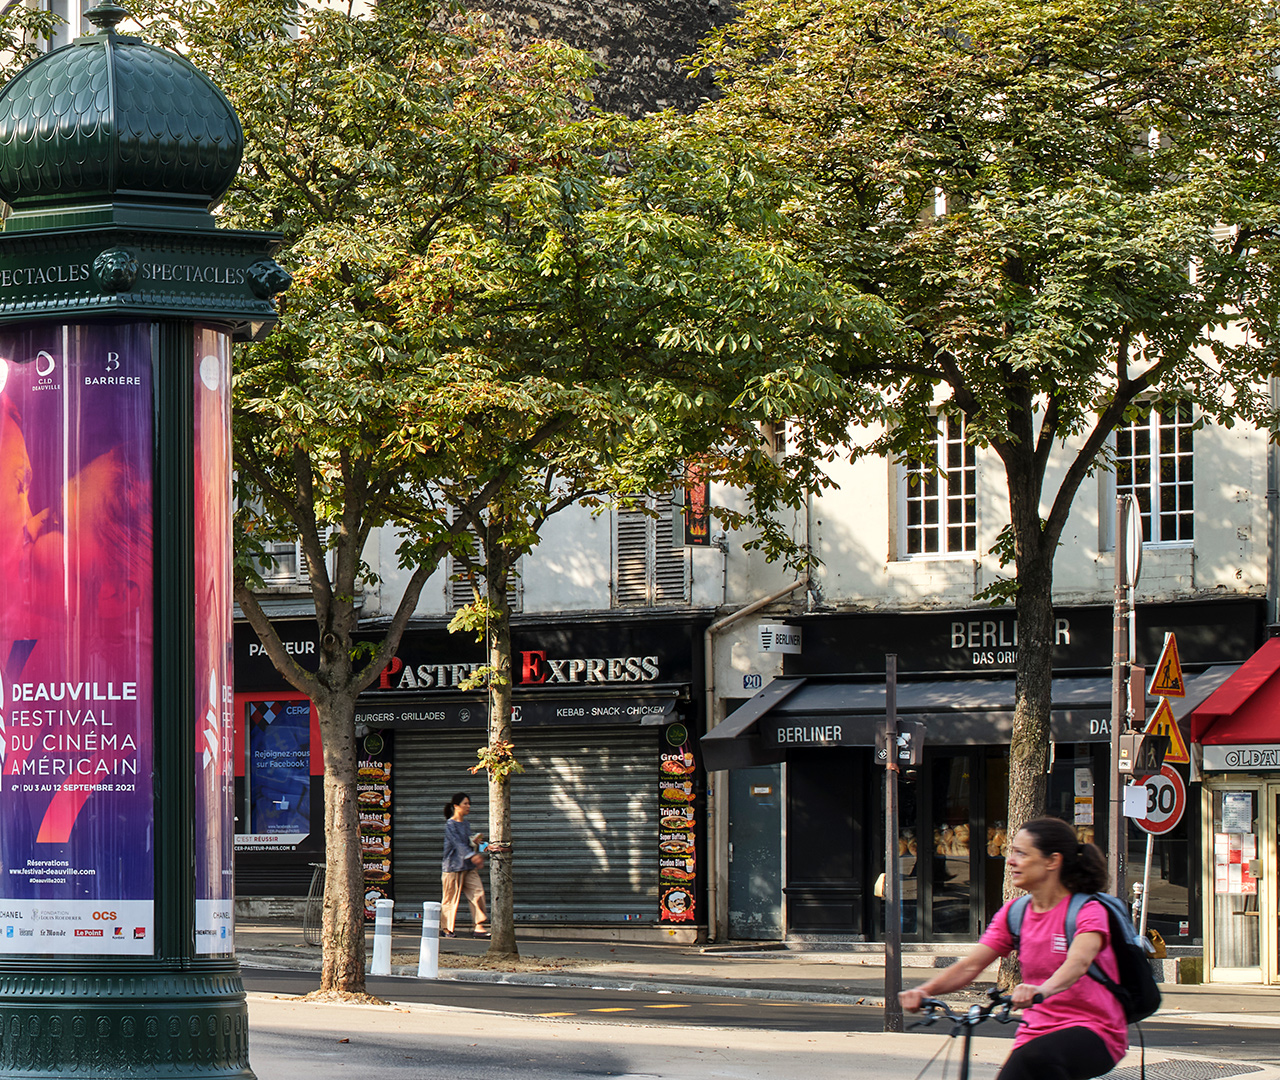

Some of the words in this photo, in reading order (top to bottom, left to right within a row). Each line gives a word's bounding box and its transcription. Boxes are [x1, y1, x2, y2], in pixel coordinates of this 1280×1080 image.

[142, 262, 246, 285] SPECTACLES
[85, 375, 140, 385] BARRIÈRE
[775, 634, 801, 646] BERLINER
[951, 619, 1071, 649] BERLIR
[249, 641, 315, 656] PAEUR
[972, 652, 995, 665] DAS
[997, 651, 1018, 664] ORI
[519, 650, 660, 684] EXPRESS
[744, 675, 762, 689] 20
[12, 682, 137, 702] DEAUVILLE
[286, 706, 303, 715] CER
[354, 712, 395, 722] BURGERS
[401, 711, 446, 721] GRILLADES
[556, 707, 585, 717] KEBAB
[591, 706, 621, 716] SNACK
[626, 706, 665, 715] CHICKEN
[12, 709, 114, 727] FESTIVAL
[778, 726, 843, 743] BERLINER
[12, 734, 34, 751] DU
[42, 731, 137, 751] CINÉMA
[255, 750, 311, 760] Rejoignez-nous
[12, 756, 137, 776] AMÉRICAIN
[270, 760, 305, 768] Facebook
[358, 760, 383, 768] Mixte
[23, 784, 34, 792] DU
[34, 784, 40, 792] 3
[40, 784, 52, 792] AU
[53, 784, 61, 792] 12
[63, 784, 114, 792] SEPTEMBRE
[115, 784, 135, 792] 2021
[1146, 784, 1175, 814] 30
[26, 859, 70, 867] Réservations
[9, 868, 96, 876] www.festival-deauville.com
[0, 911, 24, 919] CHANEL
[92, 911, 118, 921] OCS
